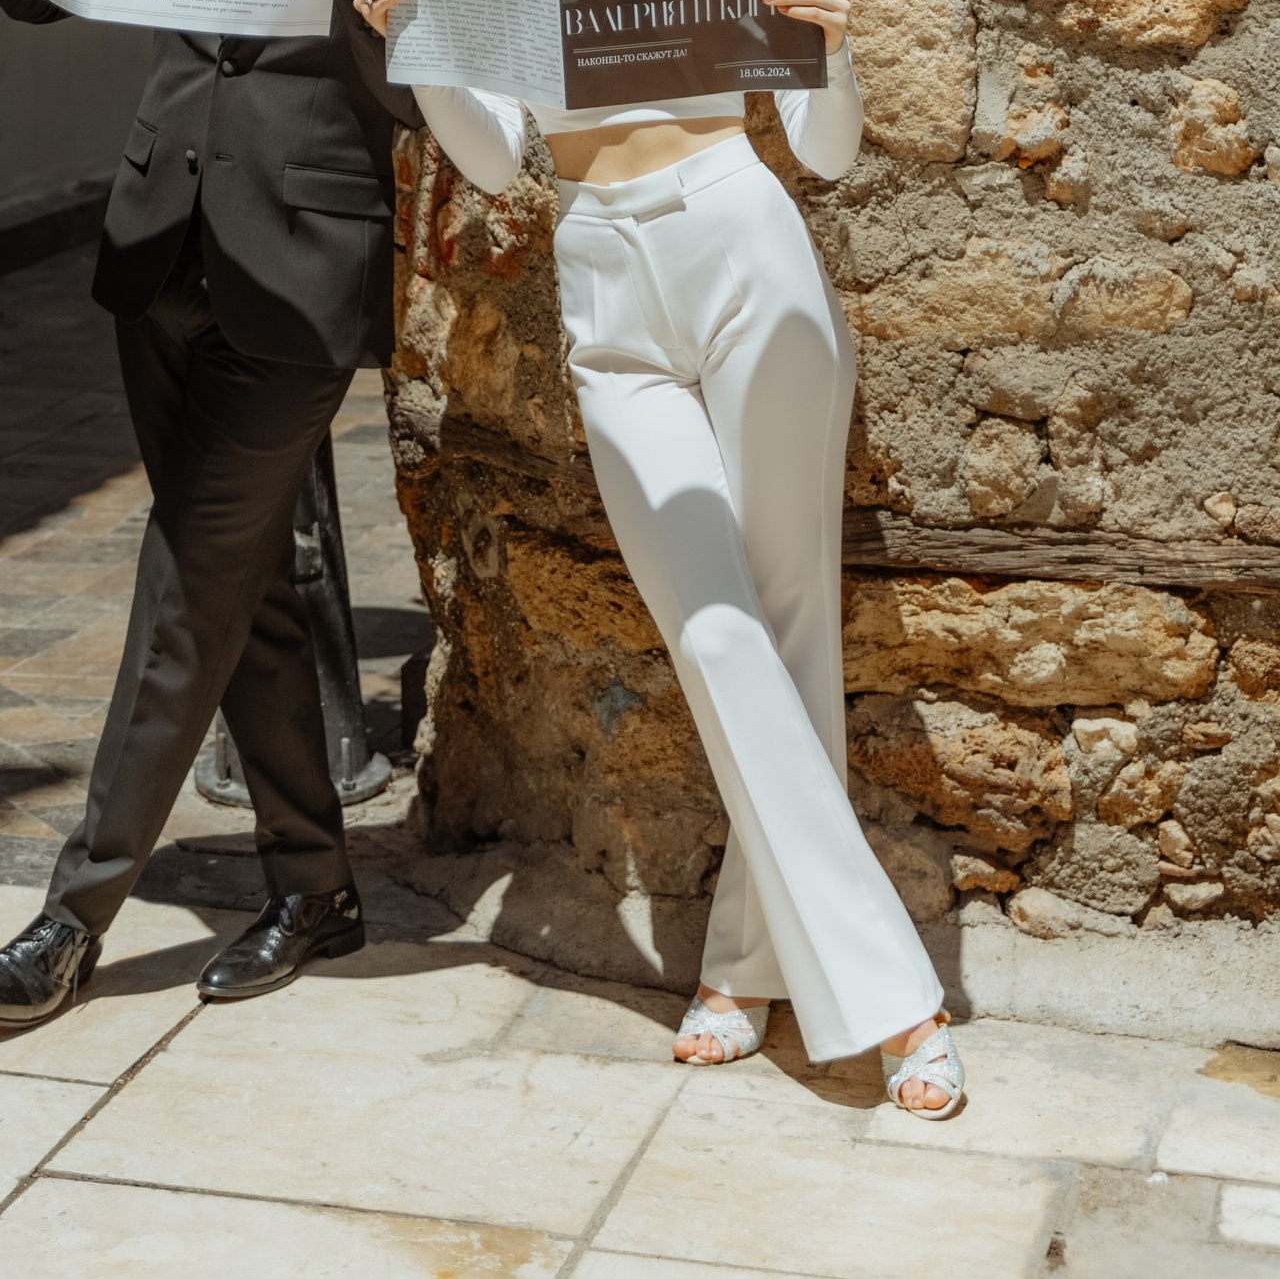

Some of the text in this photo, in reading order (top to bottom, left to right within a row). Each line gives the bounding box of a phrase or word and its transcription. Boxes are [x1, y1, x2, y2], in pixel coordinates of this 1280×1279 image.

[577, 48, 688, 67] НАКОНЕЦ-ТО СКАЖУТ ДА!
[739, 67, 791, 79] 18.06.2024
